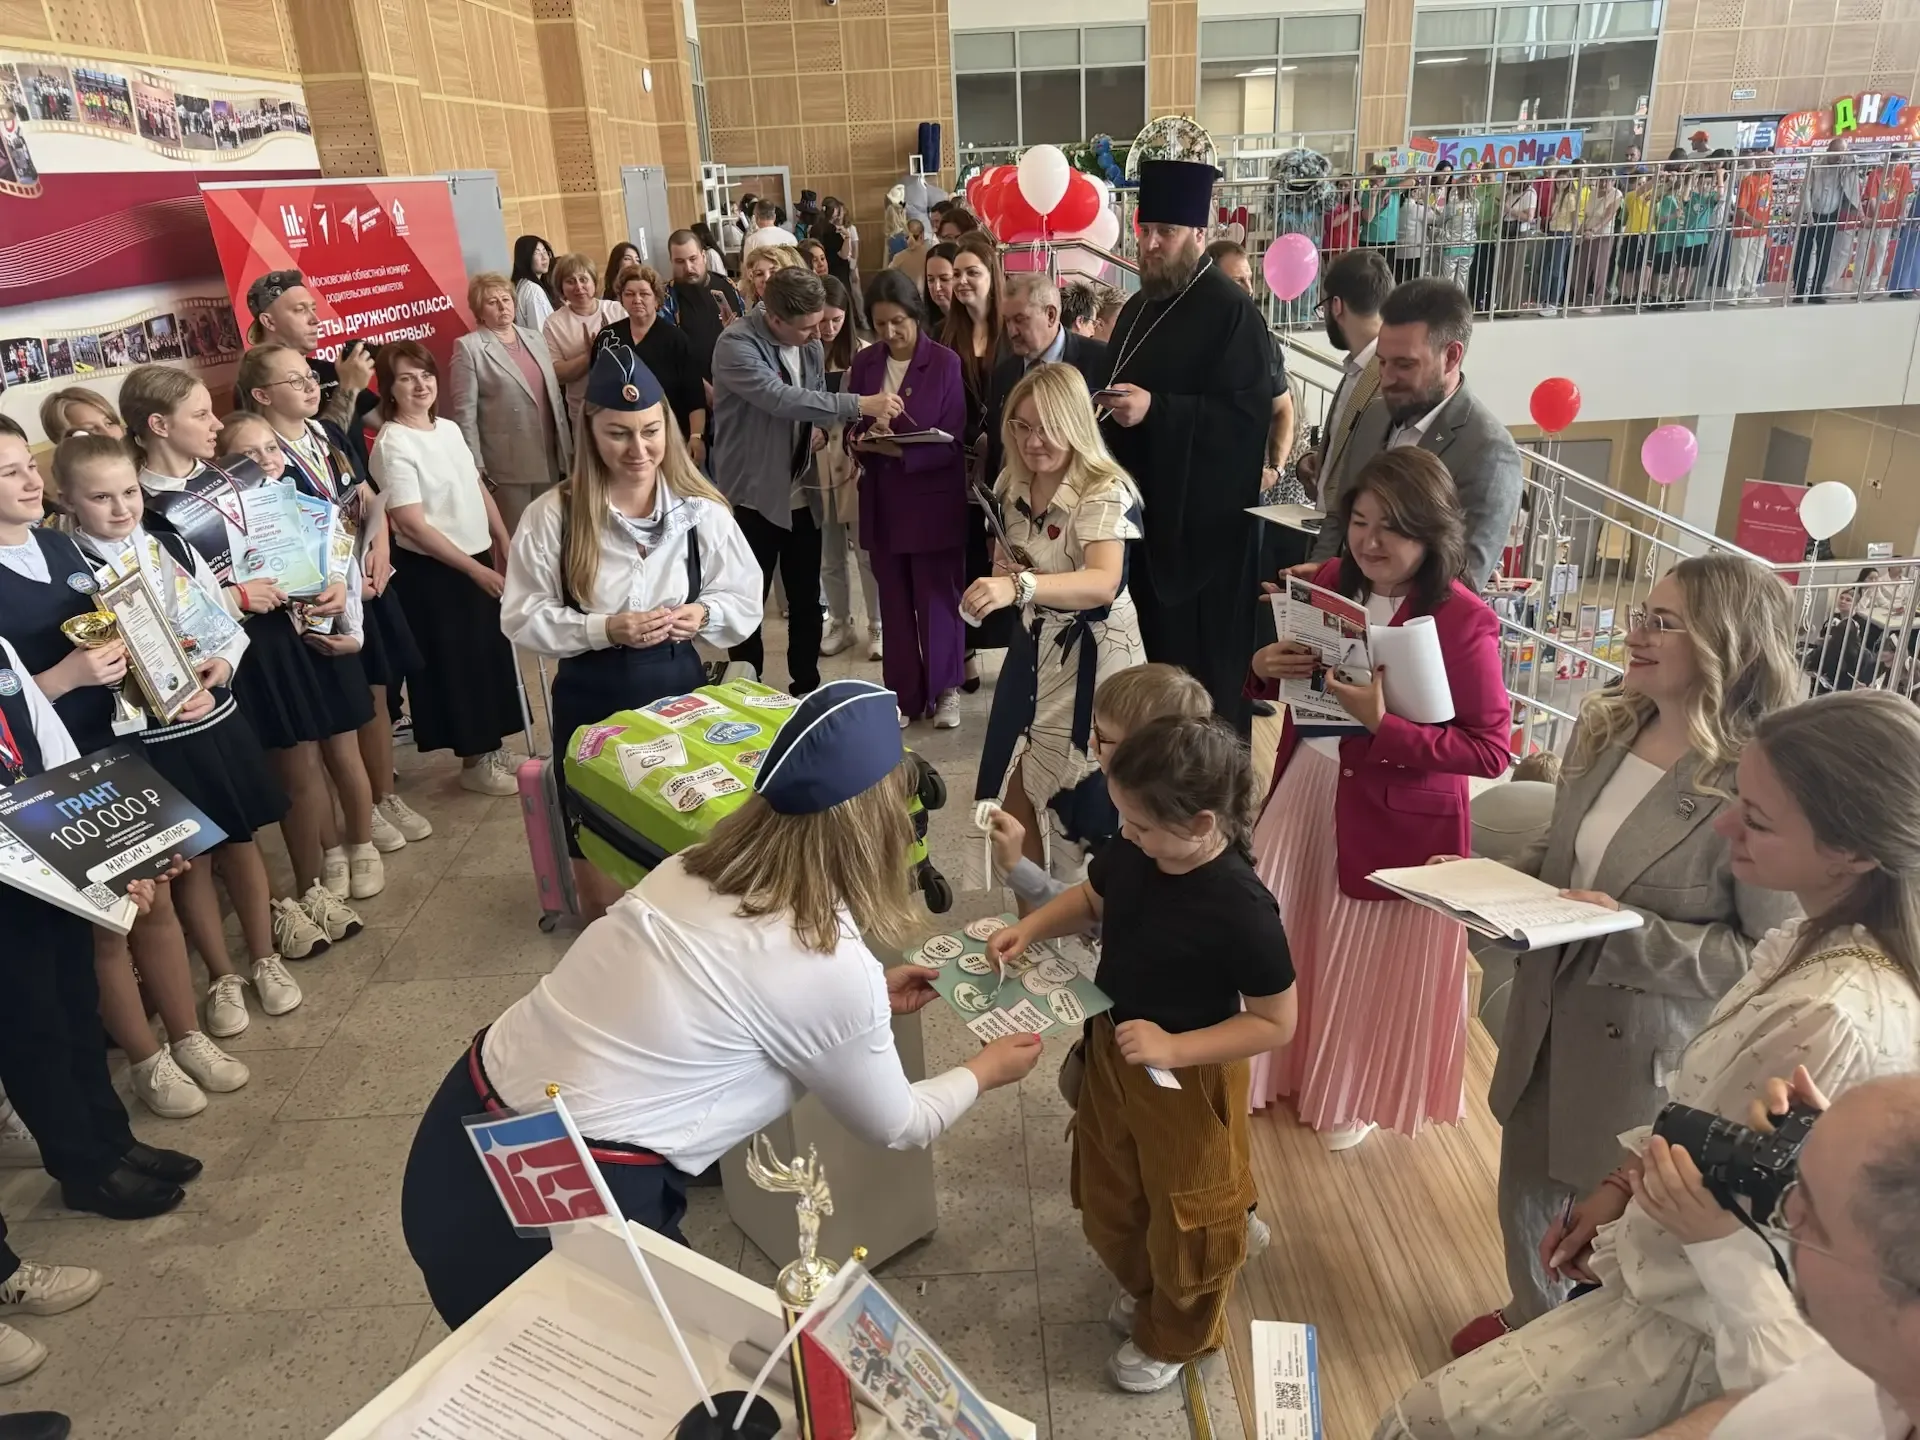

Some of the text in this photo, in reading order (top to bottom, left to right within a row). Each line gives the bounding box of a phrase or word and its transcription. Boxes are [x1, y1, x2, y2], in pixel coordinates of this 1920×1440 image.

[1835, 94, 1906, 136] ДНК
[1440, 136, 1573, 169] КОЛОМНА
[308, 263, 411, 288] Московский областной конкурс
[326, 281, 404, 304] родительских комитетов
[345, 303, 410, 335] ДРУЖНОГО
[412, 295, 455, 317] КЛАССА
[0, 799, 17, 810] АУКА.
[34, 789, 55, 803] ГЕРОЕВ
[55, 781, 122, 819] ГРАНТ
[50, 819, 100, 850] 100
[97, 796, 148, 828] 000
[104, 823, 191, 874] МАКСИМУ ЗАПАРЕ
